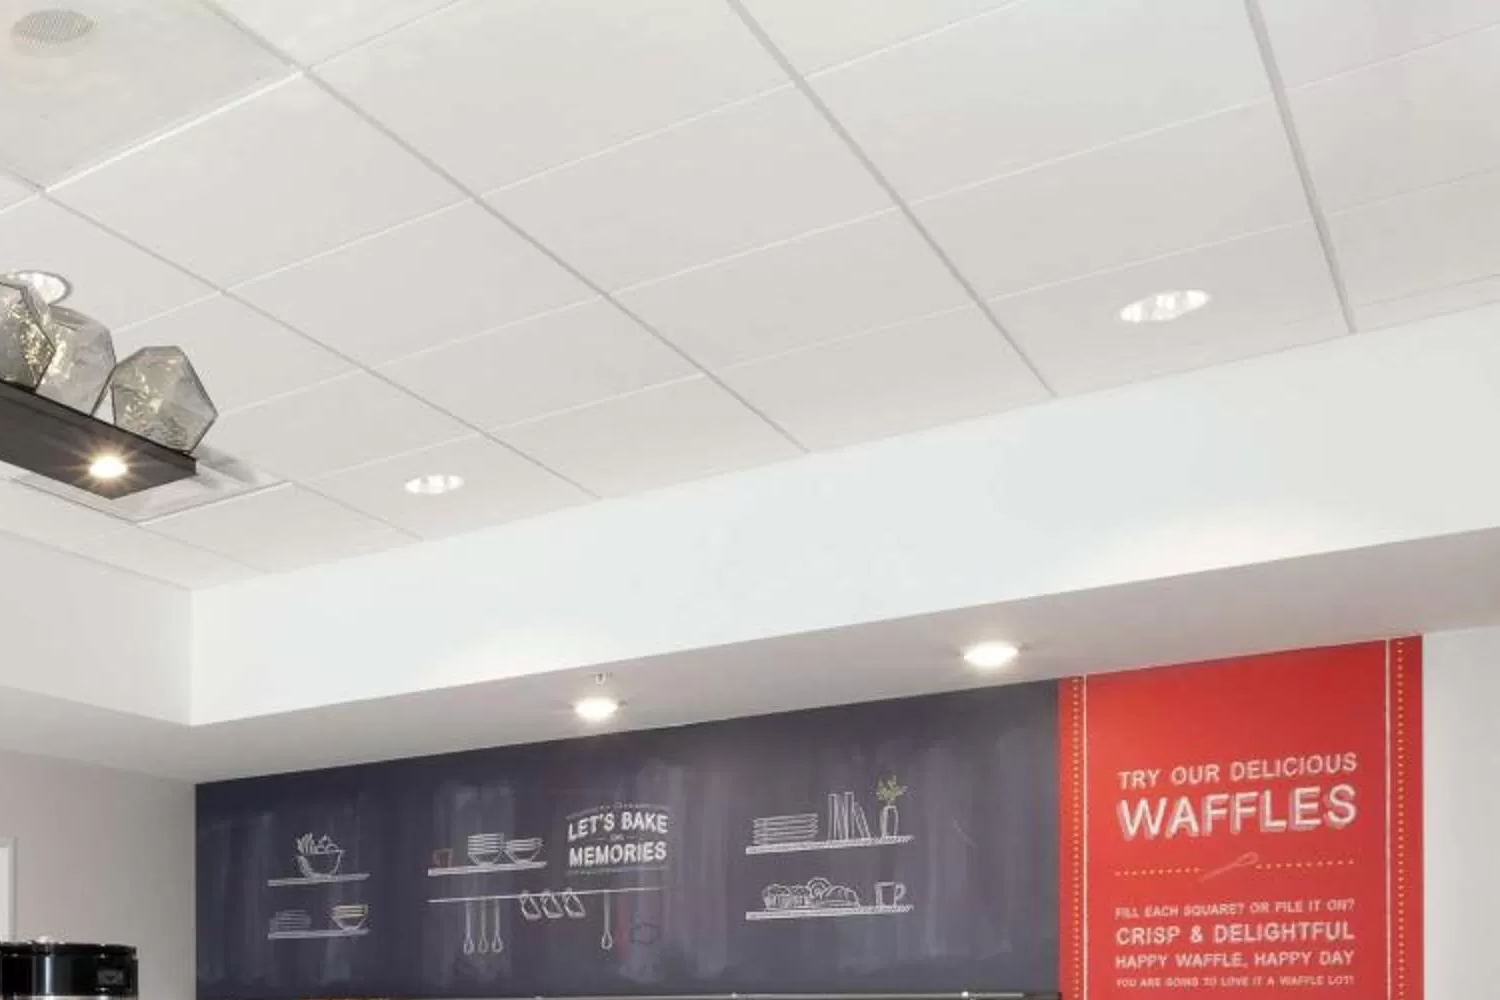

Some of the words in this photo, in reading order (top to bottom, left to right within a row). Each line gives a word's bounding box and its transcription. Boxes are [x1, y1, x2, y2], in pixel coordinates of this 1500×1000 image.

[1117, 769, 1160, 790] TRY
[1171, 763, 1220, 785] OUR
[1230, 752, 1357, 782] DELICIOUS
[1116, 783, 1357, 841] WAFFLES
[567, 812, 615, 842] LET'S
[621, 811, 668, 834] BAKE
[569, 841, 667, 868] MEMORIES
[1144, 904, 1179, 918] EACH
[1309, 899, 1321, 912] IT
[1116, 925, 1180, 946] CRISP
[1190, 924, 1203, 943] &
[1214, 919, 1355, 944] DELIGHTFUL
[1115, 953, 1167, 969] HAPPY
[1254, 950, 1312, 967] HAPPY
[1319, 949, 1354, 966] DAY
